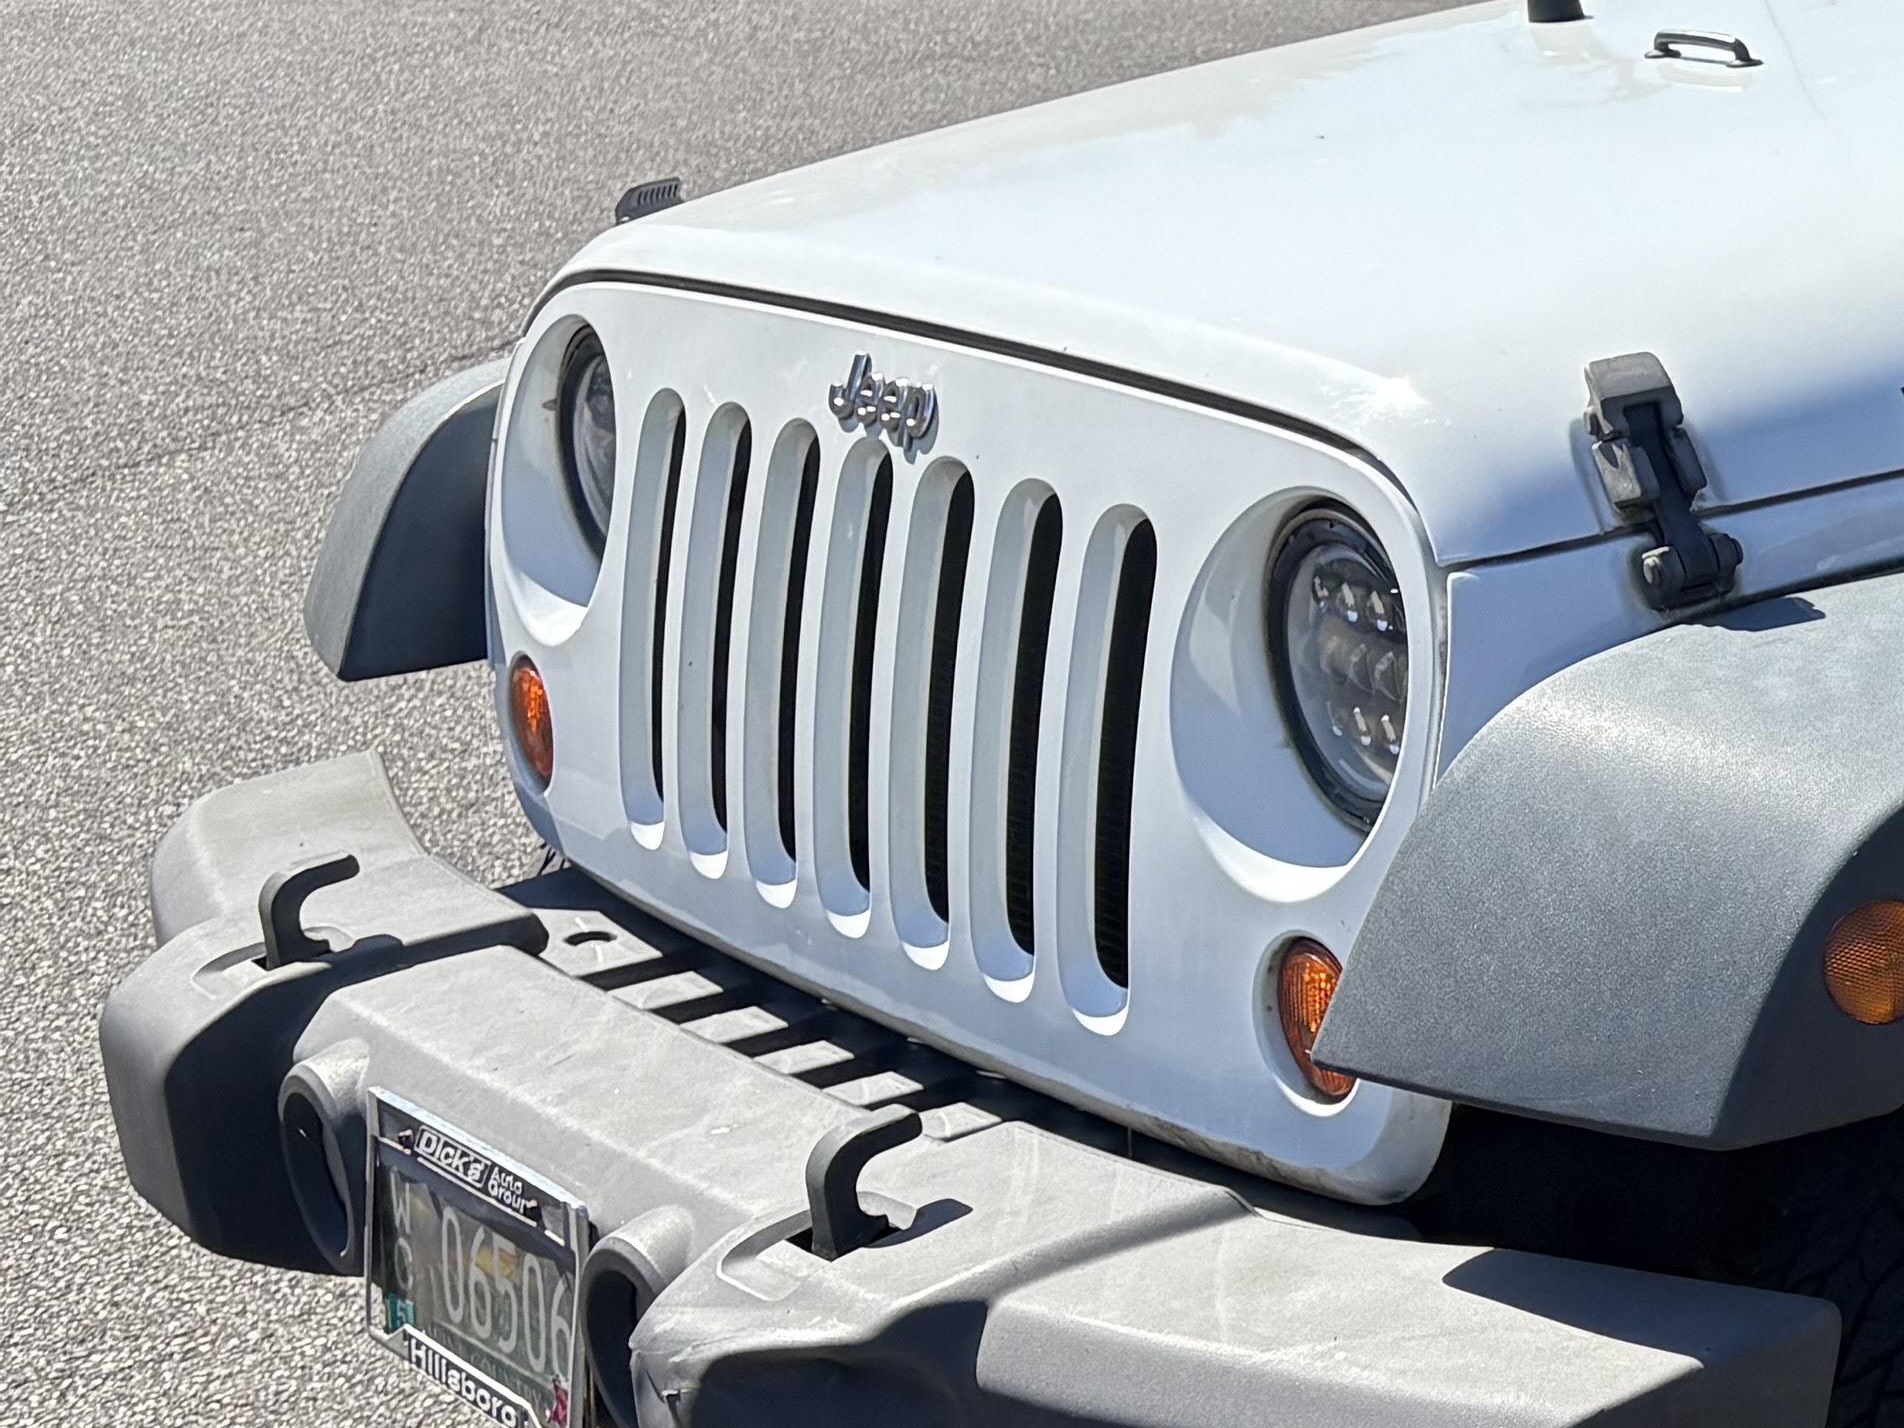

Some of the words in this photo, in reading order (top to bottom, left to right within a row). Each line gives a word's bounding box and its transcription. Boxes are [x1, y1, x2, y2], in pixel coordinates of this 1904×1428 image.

[828, 351, 936, 451] Jeep
[418, 1130, 485, 1182] Dick's
[490, 1166, 523, 1195] Auto
[442, 1206, 571, 1380] 06506
[411, 1337, 517, 1428] Hillsboro
